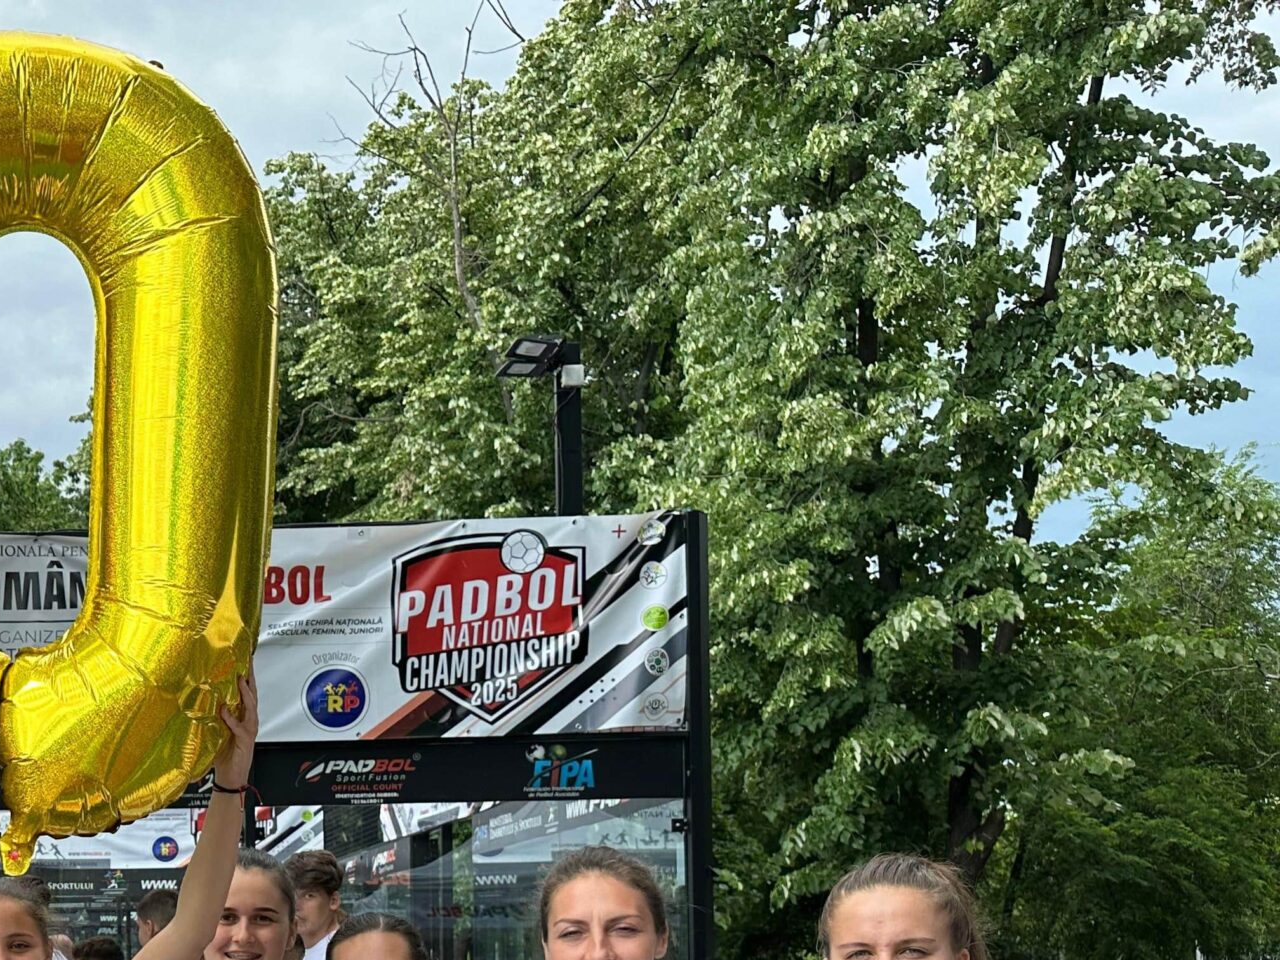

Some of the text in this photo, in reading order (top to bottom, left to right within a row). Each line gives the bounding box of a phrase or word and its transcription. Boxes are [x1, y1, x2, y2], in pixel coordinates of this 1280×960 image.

[61, 545, 88, 557] PEN
[264, 565, 332, 605] BOL
[397, 564, 582, 632] PADBOL
[306, 617, 335, 627] ECHIPĂ
[336, 616, 383, 628] NAȚIONALĂ
[311, 627, 347, 636] FEMININ,
[441, 612, 545, 650] NATIONAL
[312, 650, 360, 666] Organizator
[405, 631, 580, 692] CHAMPIONSHIP
[470, 676, 519, 707] 2025
[325, 758, 416, 773] PADBOL
[532, 759, 595, 788] FIPA
[336, 774, 366, 783] Sport
